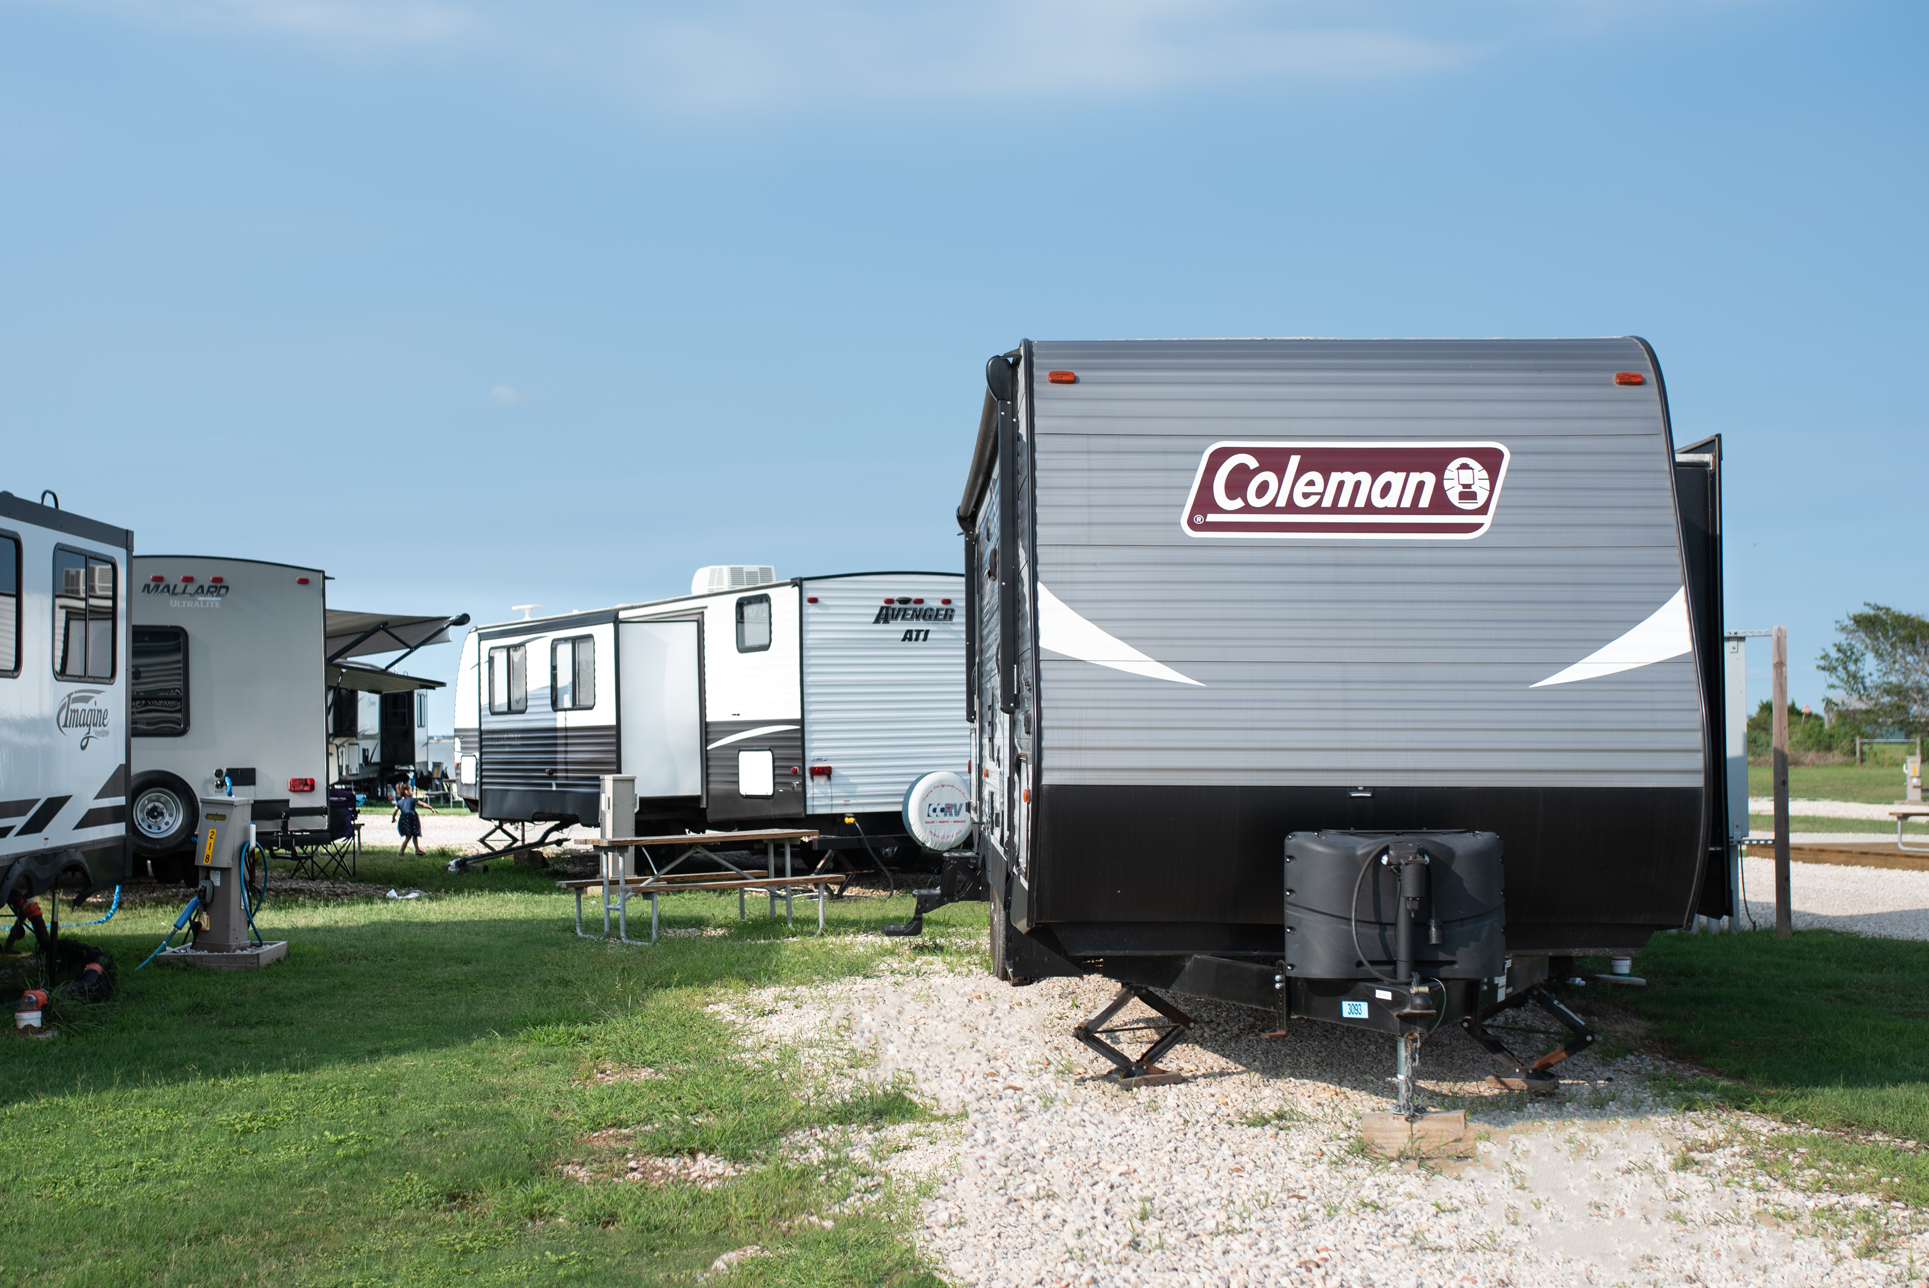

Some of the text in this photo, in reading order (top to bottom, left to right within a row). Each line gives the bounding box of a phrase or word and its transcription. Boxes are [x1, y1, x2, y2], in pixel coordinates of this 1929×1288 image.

[1213, 453, 1436, 511] Coleman
[141, 583, 229, 598] MALLARD
[872, 605, 956, 625] AVENGER
[900, 629, 931, 642] ATI
[61, 691, 110, 751] Imagine
